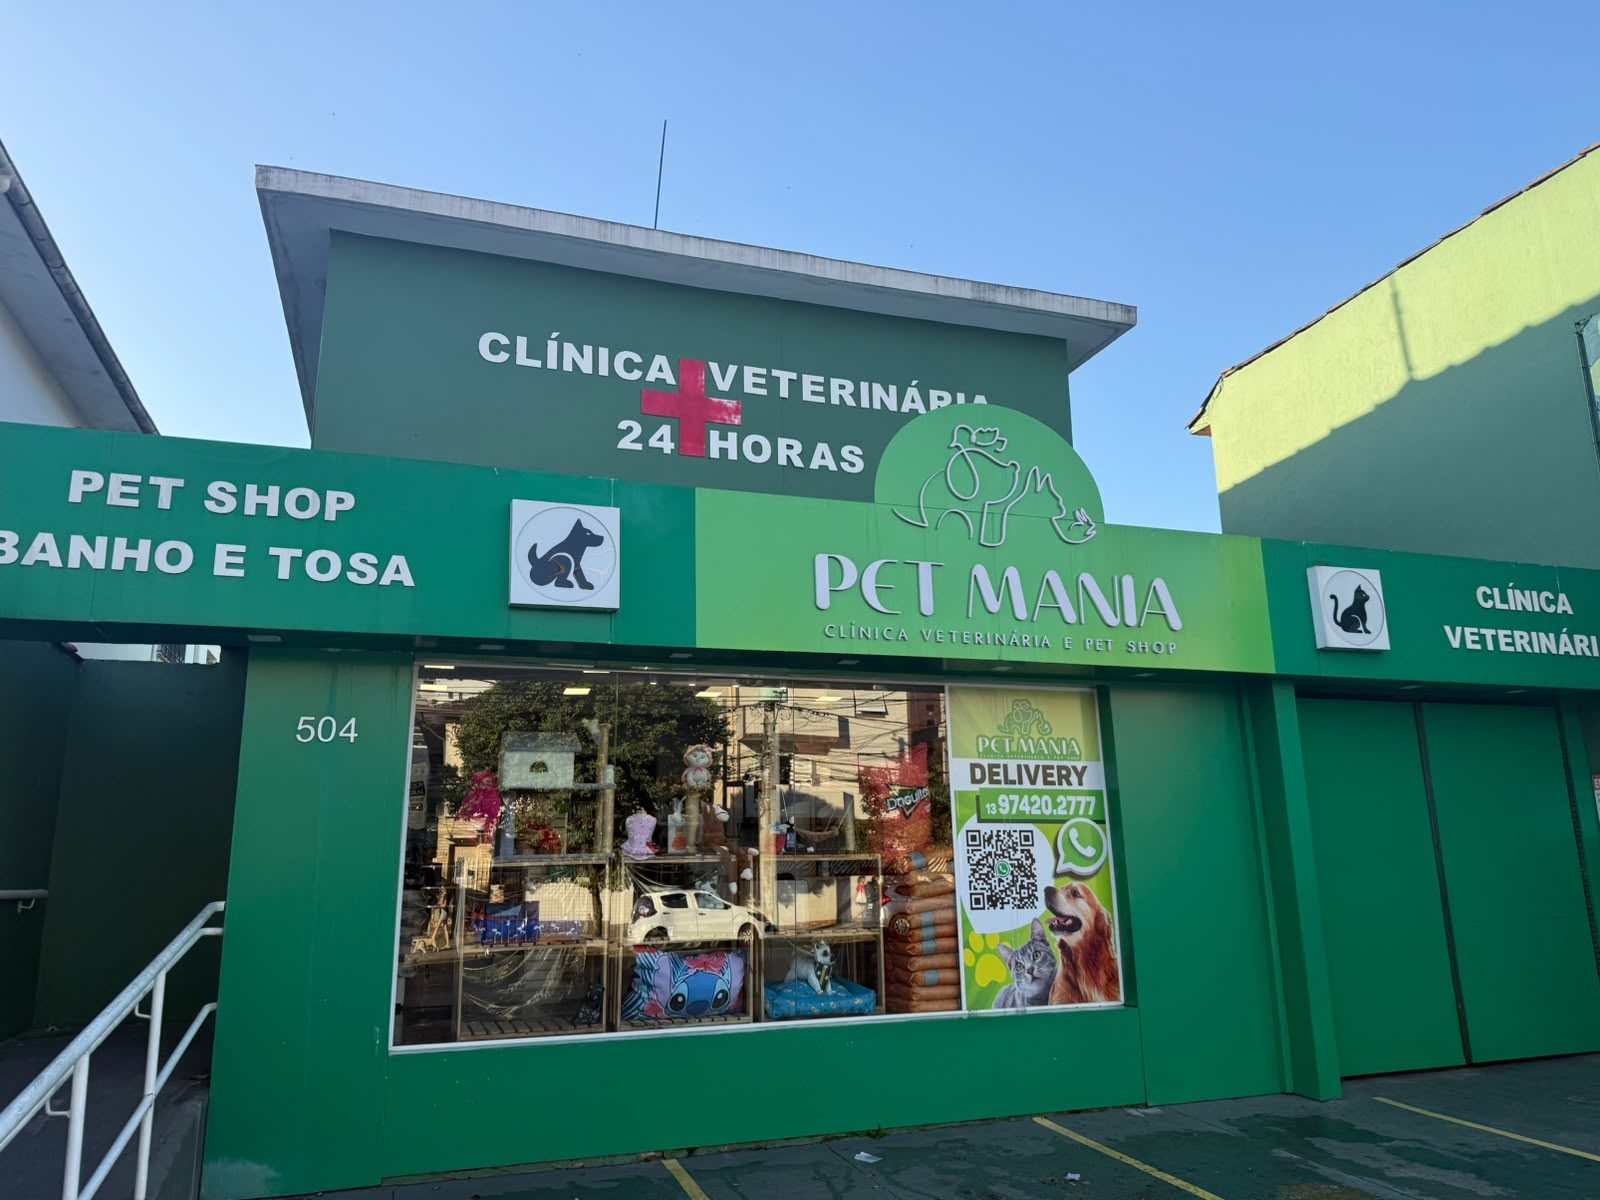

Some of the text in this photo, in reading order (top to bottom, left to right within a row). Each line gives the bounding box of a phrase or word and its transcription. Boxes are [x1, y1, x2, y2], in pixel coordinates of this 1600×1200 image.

[478, 332, 988, 414] CLÍNICA VETERINÁR
[617, 420, 865, 474] 24 HORAS
[68, 469, 356, 522] PET SHOP
[213, 543, 247, 578] E
[268, 546, 416, 588] TOSA
[815, 553, 1183, 632] PET MANIA
[1476, 582, 1574, 615] CLÍNICA
[824, 621, 1178, 655] CLÍNICA VETERINÁRIA E PET SHOP
[295, 715, 359, 744] 504
[978, 736, 1081, 756] PET MANIA
[969, 762, 1089, 787] DELIVERY
[985, 793, 1097, 816] 13 97420.2777
